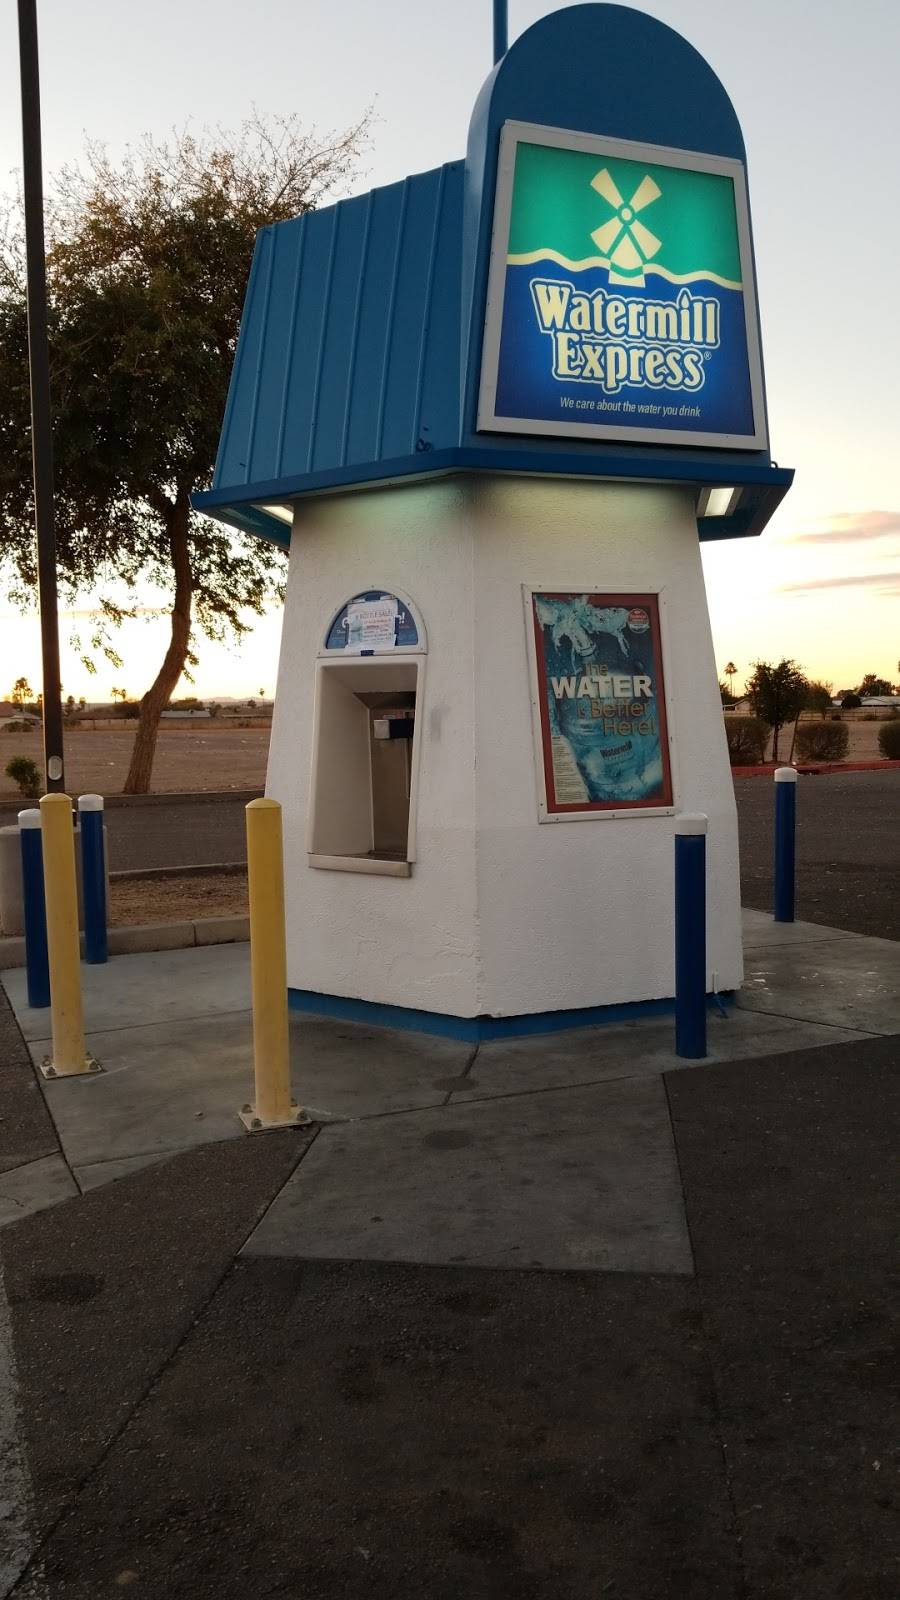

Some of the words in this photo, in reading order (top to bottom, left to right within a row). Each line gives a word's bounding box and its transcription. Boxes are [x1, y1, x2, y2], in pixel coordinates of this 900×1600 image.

[533, 282, 718, 345] Watermill
[560, 396, 575, 408] We
[575, 398, 595, 410] care
[597, 399, 622, 412] about
[623, 400, 636, 413] the
[637, 403, 662, 415] water
[662, 405, 679, 417] you
[679, 404, 702, 418] drink
[551, 675, 654, 699] WATER
[591, 699, 649, 719] Better
[604, 719, 656, 736] Here!
